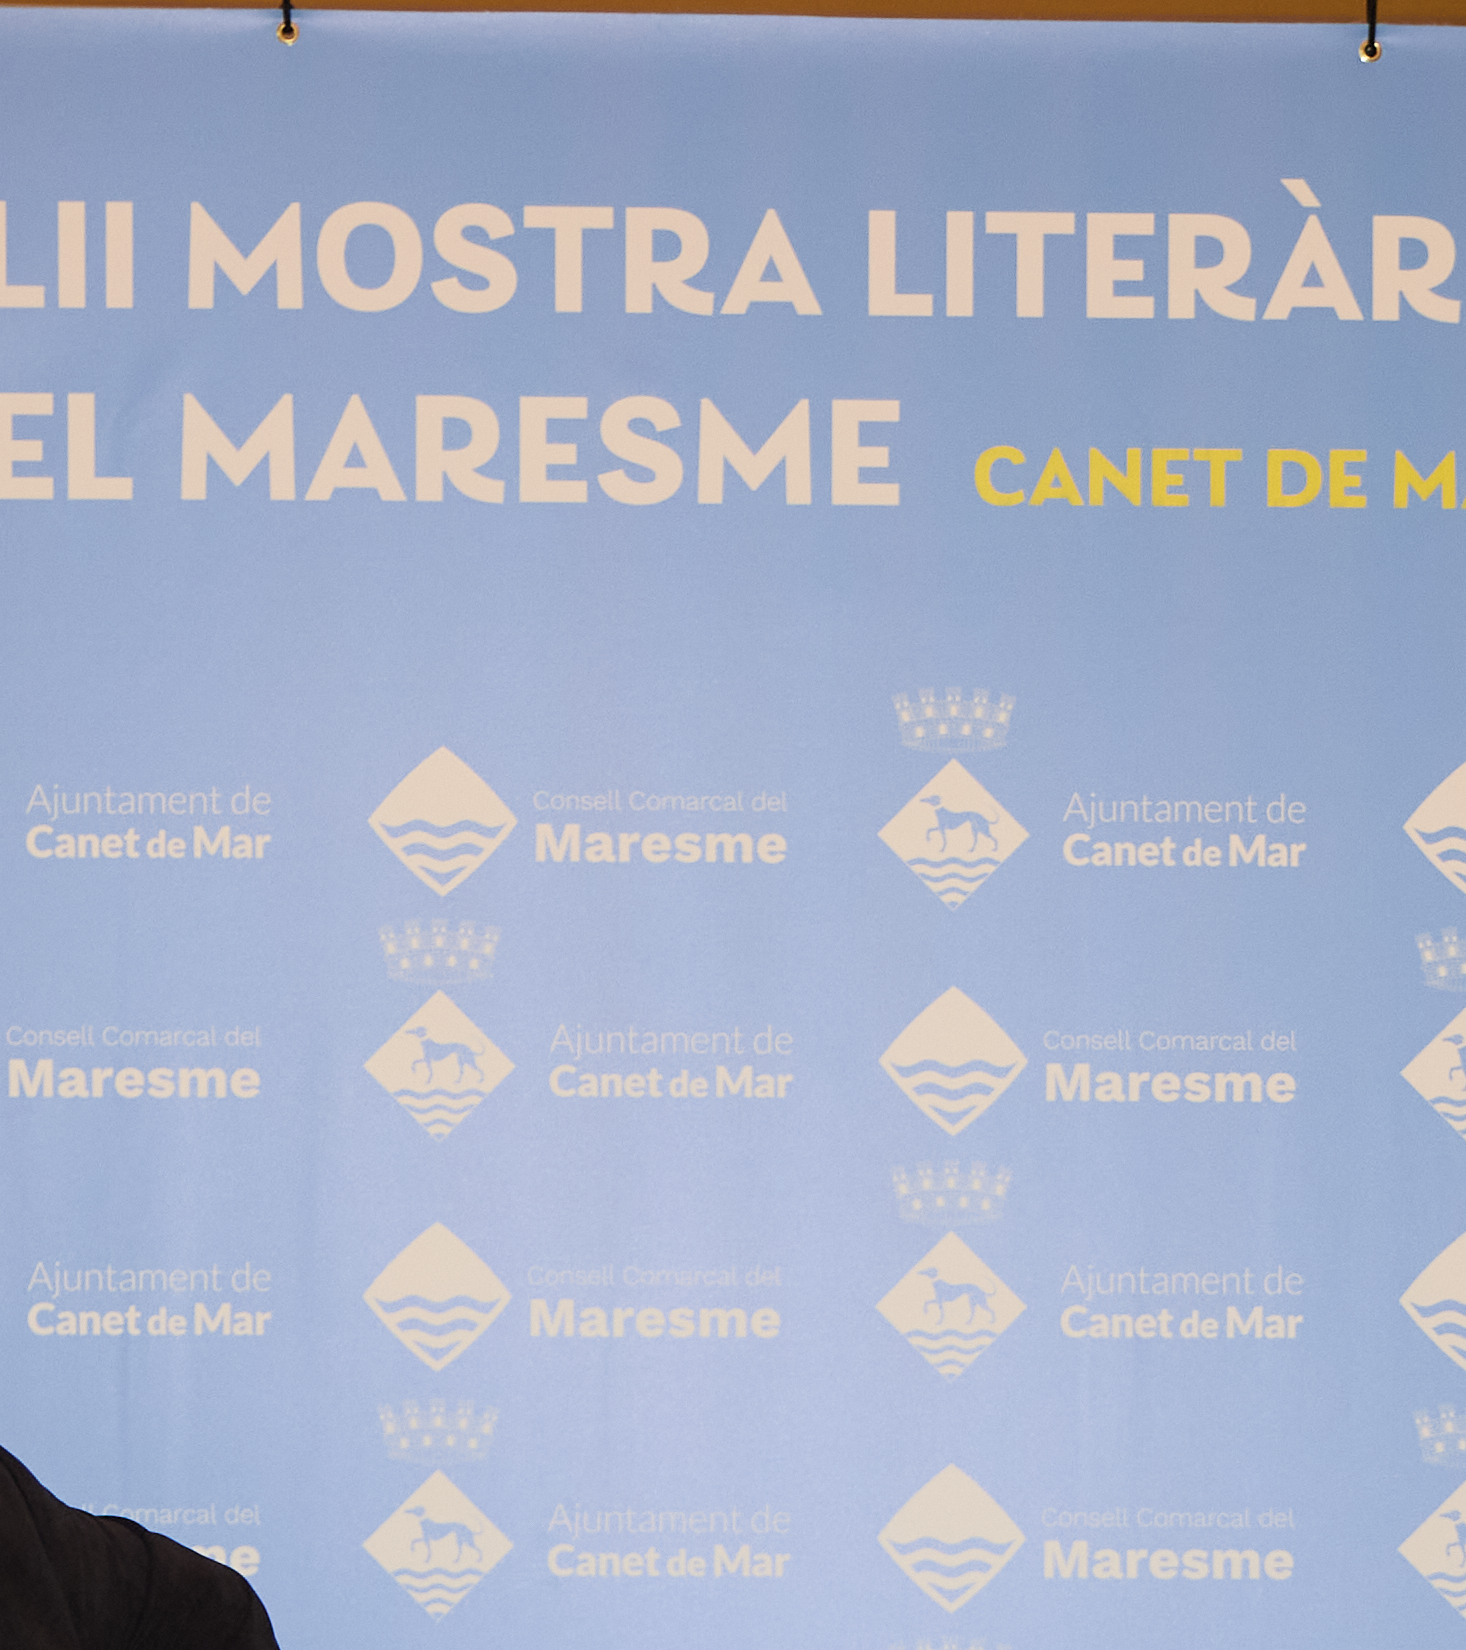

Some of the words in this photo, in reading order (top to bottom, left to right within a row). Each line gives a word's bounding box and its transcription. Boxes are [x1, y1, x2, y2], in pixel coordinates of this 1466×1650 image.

[188, 201, 822, 315] MOSTRA
[181, 393, 900, 506] MARESME
[975, 446, 1242, 507] CANET
[1267, 449, 1366, 509] DE
[25, 783, 222, 821] Ajuntament
[230, 784, 272, 816] de
[532, 789, 622, 812] Consell
[628, 790, 744, 812] Comarcal
[751, 791, 787, 812] del
[1062, 791, 1258, 830] Ajuntament
[1265, 793, 1307, 824] de
[25, 824, 140, 859] Canet
[146, 829, 187, 859] de
[193, 825, 272, 859] Mar
[535, 823, 787, 864] Maresme
[1062, 832, 1177, 867] Canet
[1182, 837, 1222, 867] de
[1229, 833, 1307, 867] Mar
[27, 1261, 222, 1298] Ajuntament
[230, 1261, 272, 1293] de
[27, 1301, 141, 1336] Canet
[147, 1306, 188, 1336] de
[194, 1302, 272, 1336] Mar
[547, 1503, 742, 1540] Ajuntament
[750, 1504, 791, 1534] de
[1040, 1506, 1129, 1529] Consell
[1136, 1507, 1251, 1529] Comarcal
[1257, 1508, 1295, 1528] del
[547, 1543, 661, 1577] Canet
[666, 1548, 707, 1577] de
[713, 1544, 791, 1578] Mar
[1043, 1539, 1294, 1580] Maresme
